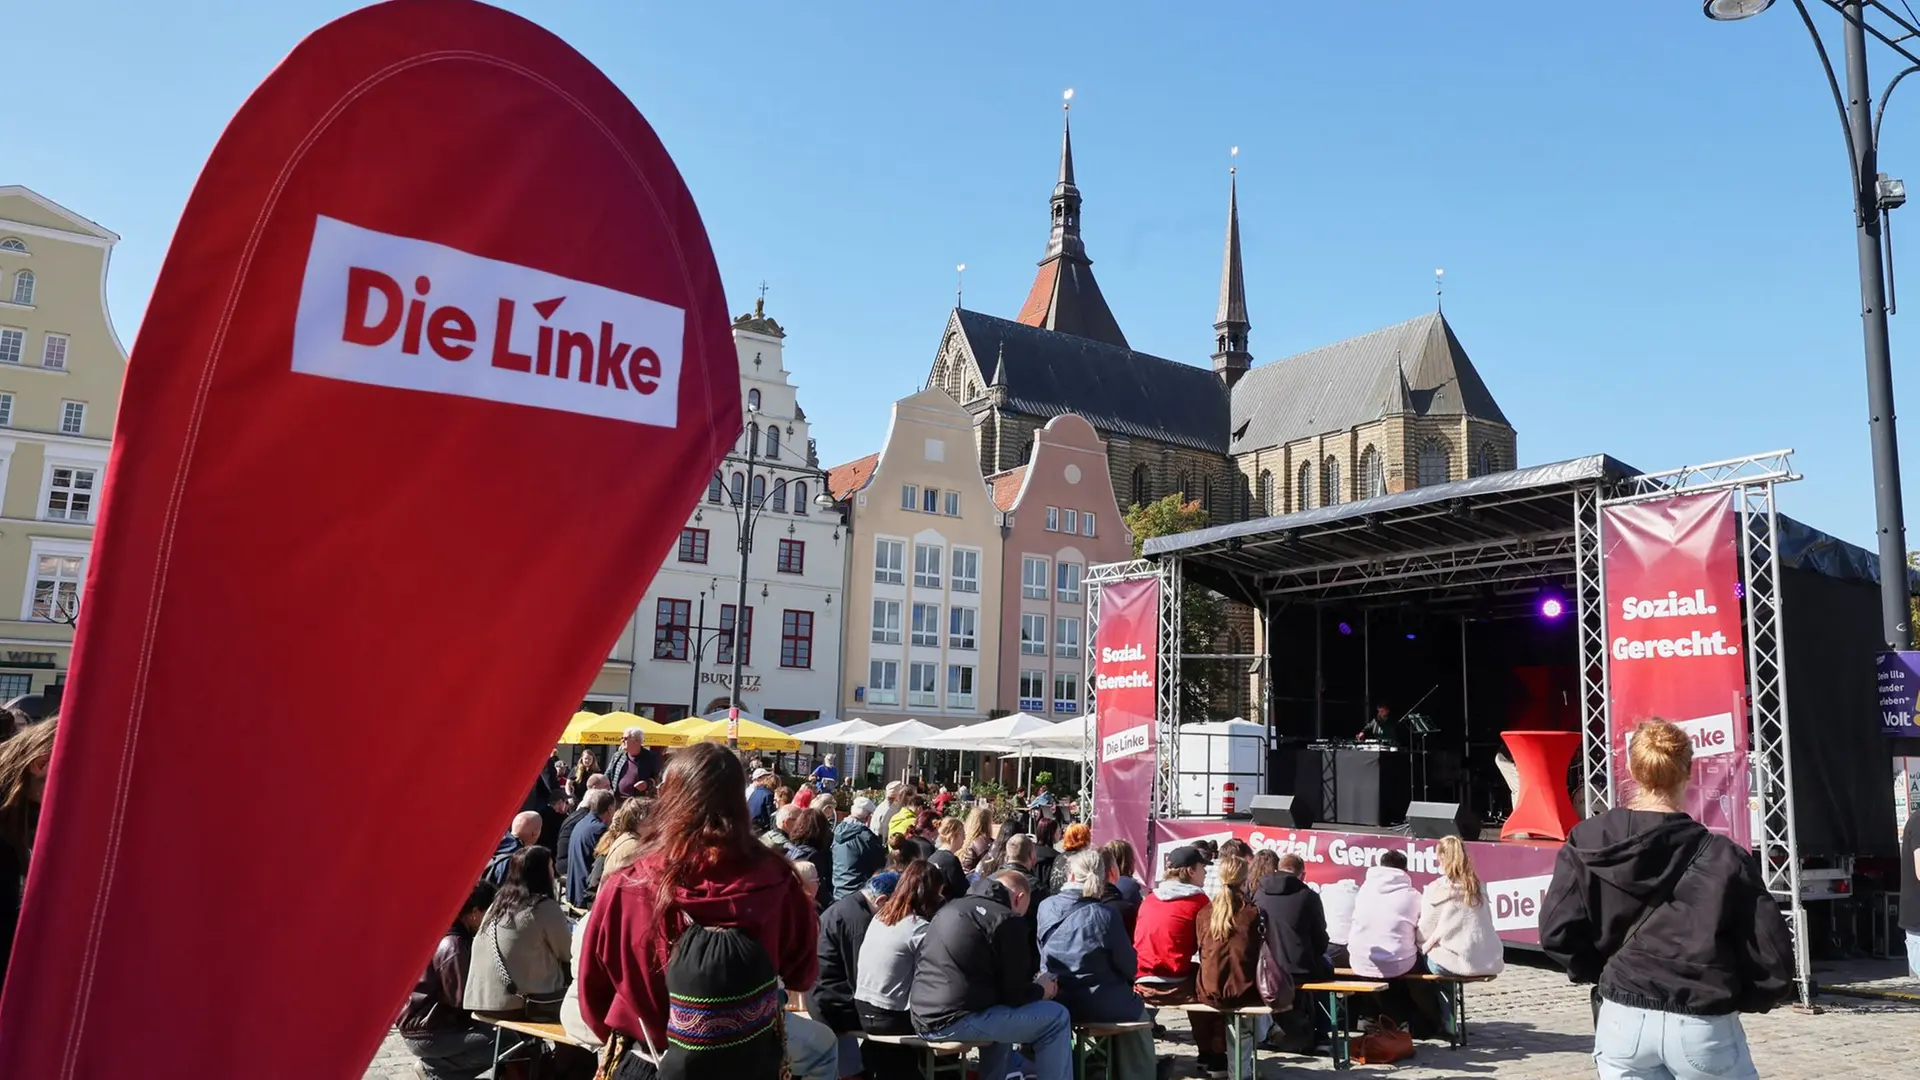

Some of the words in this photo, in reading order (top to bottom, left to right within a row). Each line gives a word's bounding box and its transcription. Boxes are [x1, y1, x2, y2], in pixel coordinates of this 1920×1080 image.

[342, 266, 477, 362] Die
[491, 295, 662, 396] Linke
[1622, 589, 1717, 620] Sozial.
[1102, 643, 1146, 663] Sozial.
[1612, 630, 1738, 660] Gerecht.
[1097, 670, 1152, 689] Gerecht.
[1890, 670, 1905, 679] lila
[1883, 711, 1911, 726] Volt
[1106, 741, 1119, 755] Die
[1120, 734, 1144, 751] Linke
[1690, 728, 1725, 748] nke
[1328, 839, 1447, 874] Gerht.
[1496, 891, 1535, 919] Die
